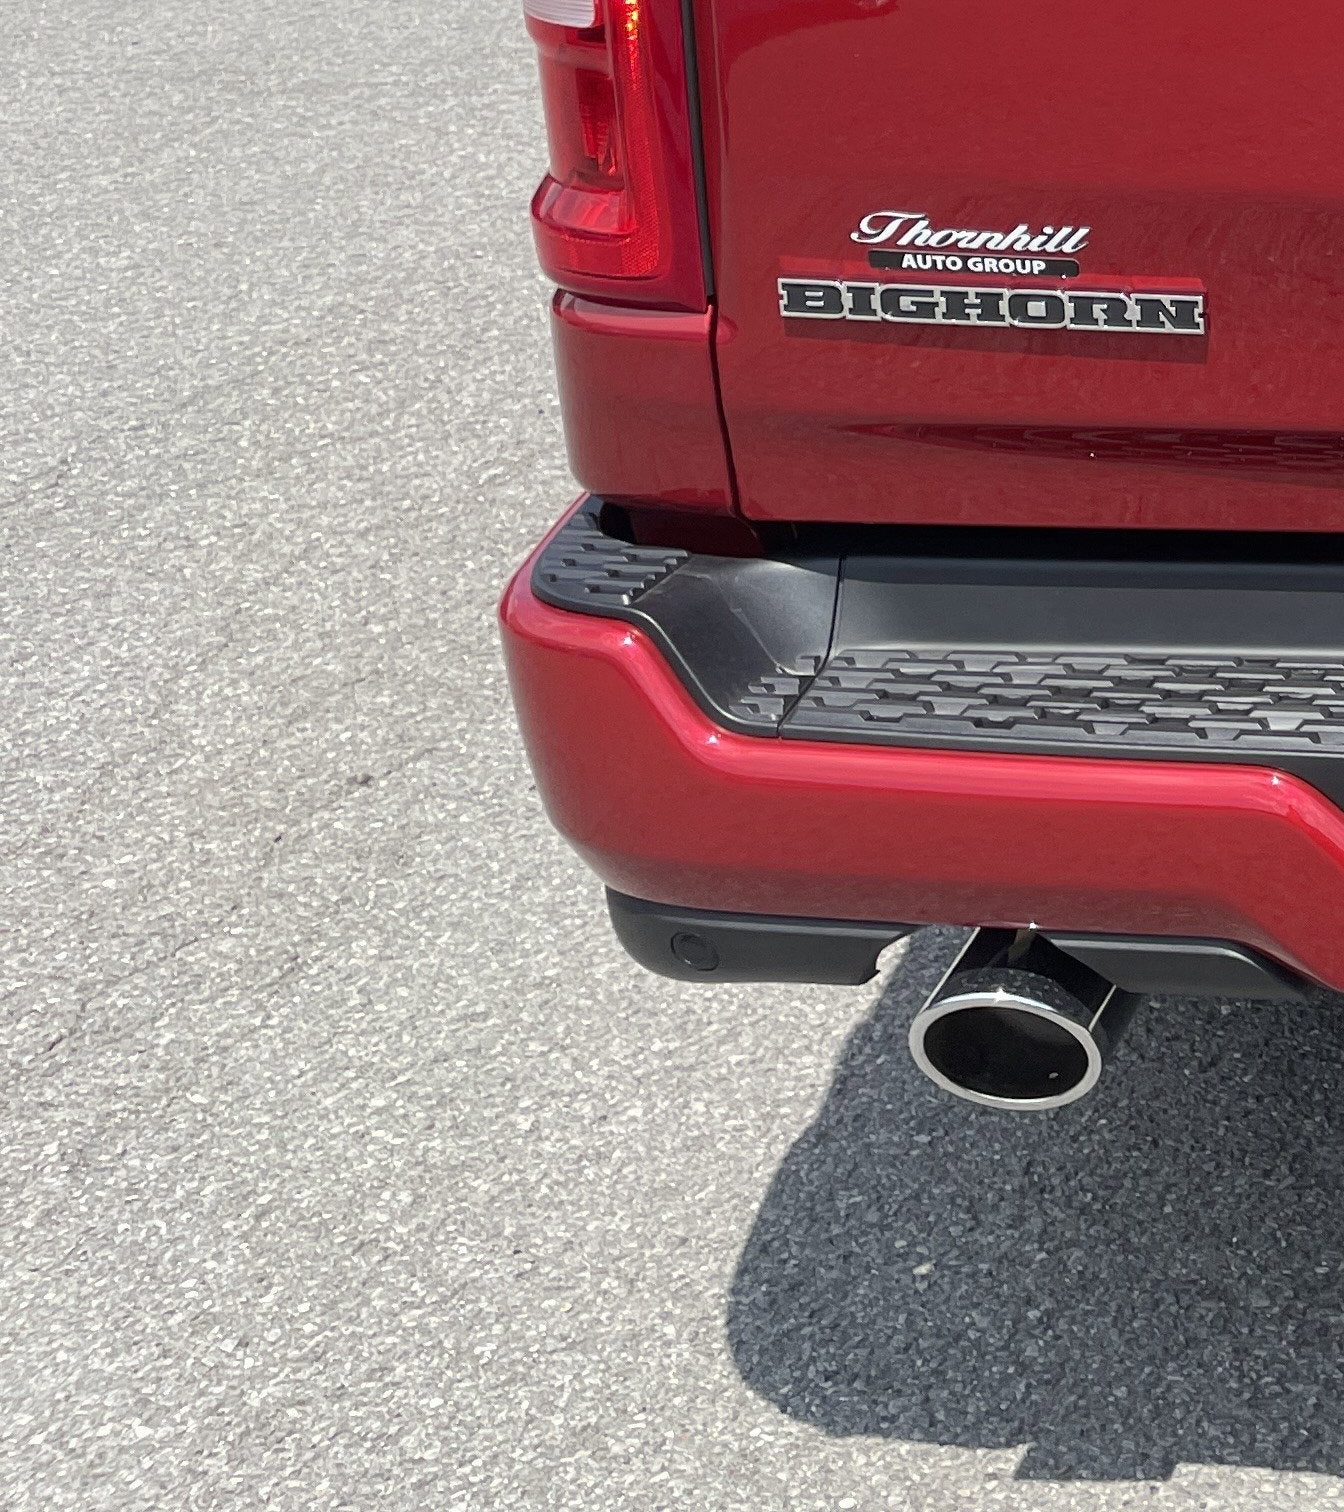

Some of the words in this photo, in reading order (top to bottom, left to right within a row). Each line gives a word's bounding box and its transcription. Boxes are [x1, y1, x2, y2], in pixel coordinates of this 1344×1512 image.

[849, 209, 1091, 254] Thornhill
[901, 252, 961, 272] AUTO
[966, 256, 1047, 276] GROUP
[777, 277, 1205, 336] BIGHORN
